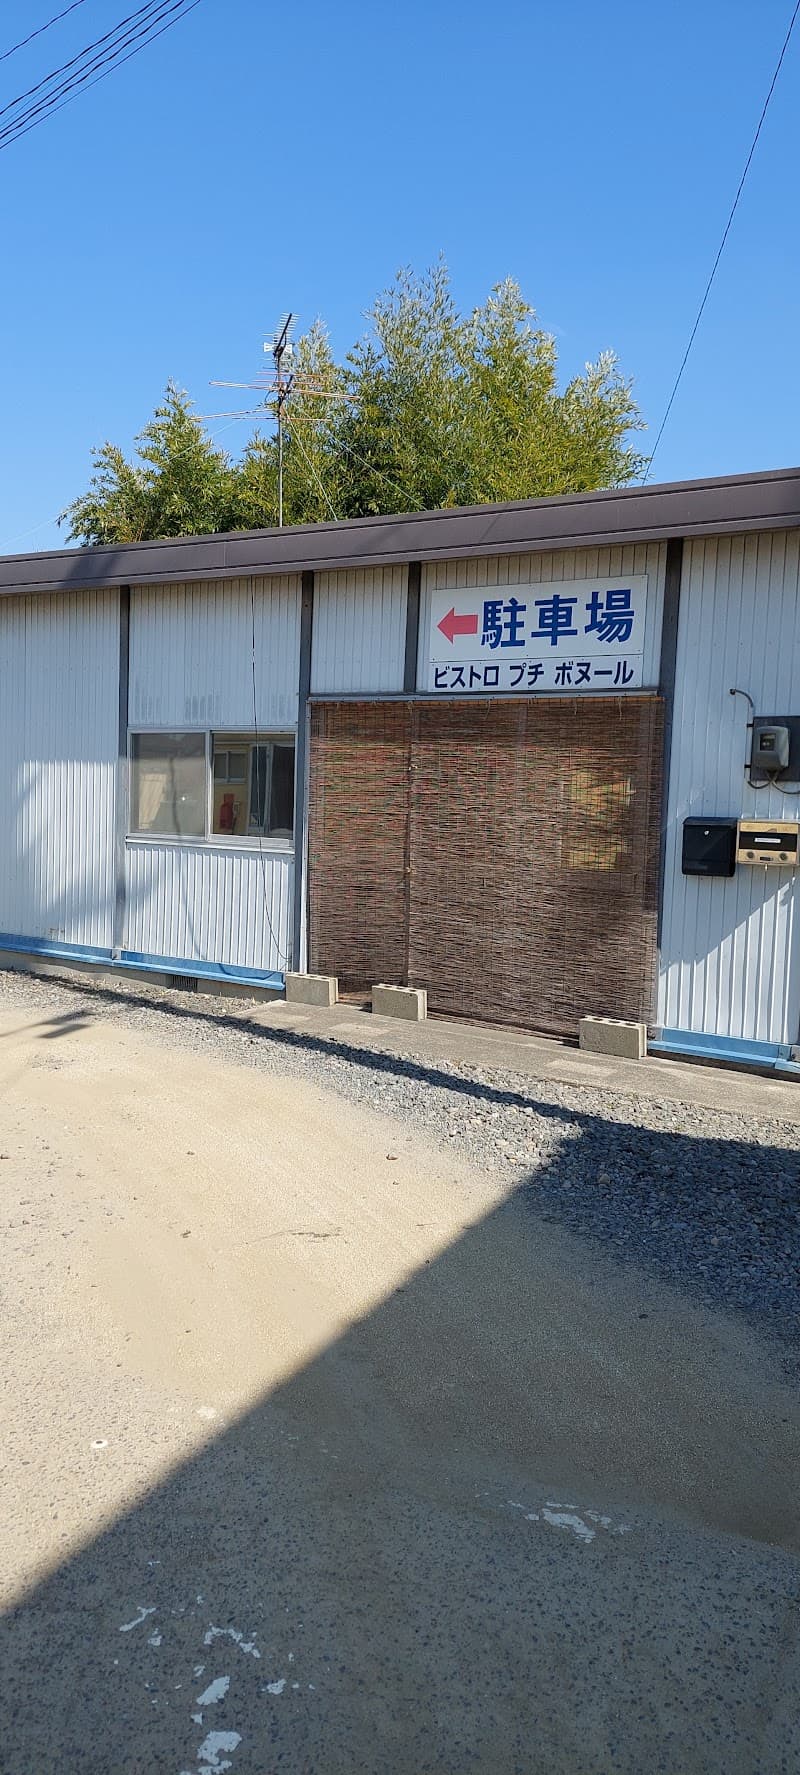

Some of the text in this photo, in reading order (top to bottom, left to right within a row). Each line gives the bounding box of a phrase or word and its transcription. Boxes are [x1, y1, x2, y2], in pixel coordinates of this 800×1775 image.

[481, 589, 634, 649] 駐車場
[434, 660, 634, 688] ビストロ プチ ボヌール
